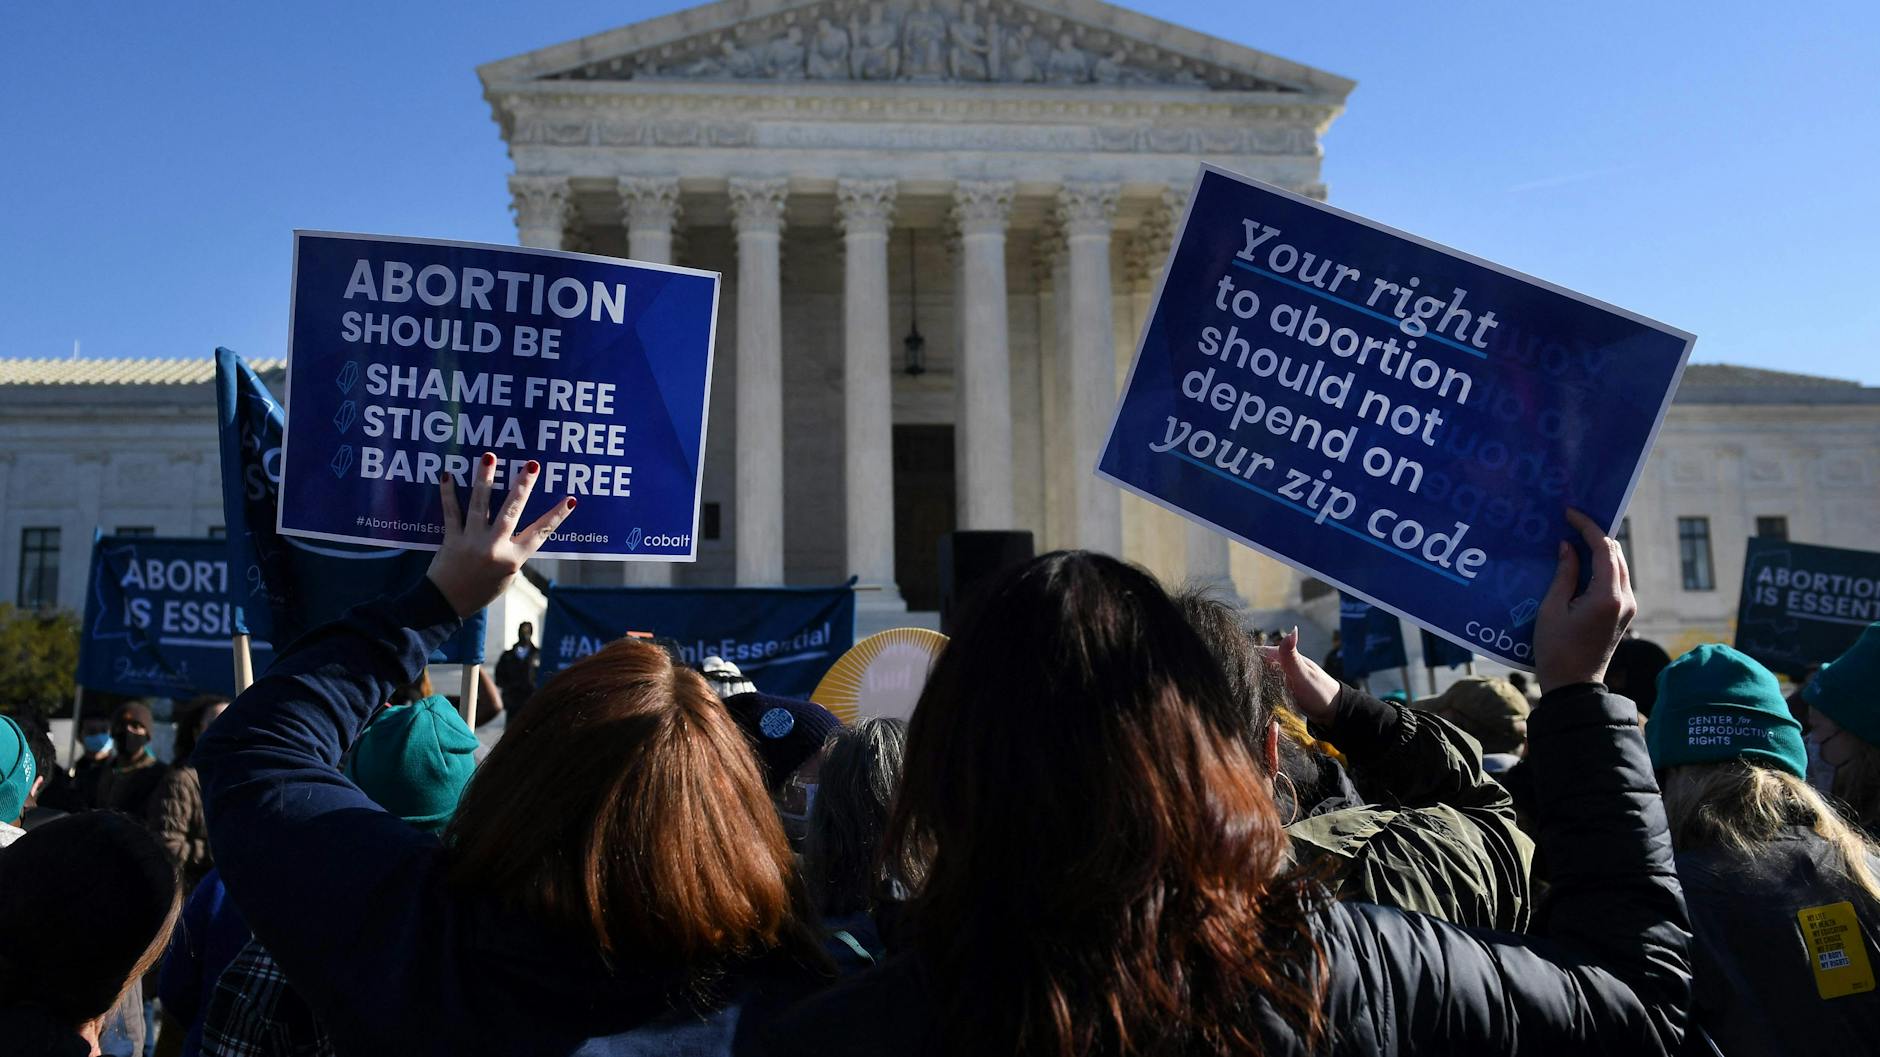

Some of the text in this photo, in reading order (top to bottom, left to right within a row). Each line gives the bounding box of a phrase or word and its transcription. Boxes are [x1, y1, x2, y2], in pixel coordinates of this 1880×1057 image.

[343, 258, 627, 325] ABORTION
[1235, 217, 1499, 349] Your right
[341, 311, 562, 360] SHOULD BE
[1215, 274, 1473, 405] to abortion
[365, 362, 617, 415] SHAME FREE
[1197, 325, 1356, 409] should
[1357, 389, 1444, 447] not
[363, 405, 627, 457] STIGMA FREE
[1181, 367, 1424, 494] depend on
[544, 461, 632, 497] FREE
[1149, 415, 1487, 580] your zip code
[356, 515, 609, 544] #AbortionIsEss OurBodies
[643, 534, 691, 548] cobalt
[121, 558, 228, 593] ABORT
[124, 596, 152, 629] IS
[1755, 584, 1880, 620] IS ESSENT
[1465, 621, 1532, 659] coba
[1688, 715, 1752, 726] CENTER for
[1688, 736, 1731, 745] RIGHTS
